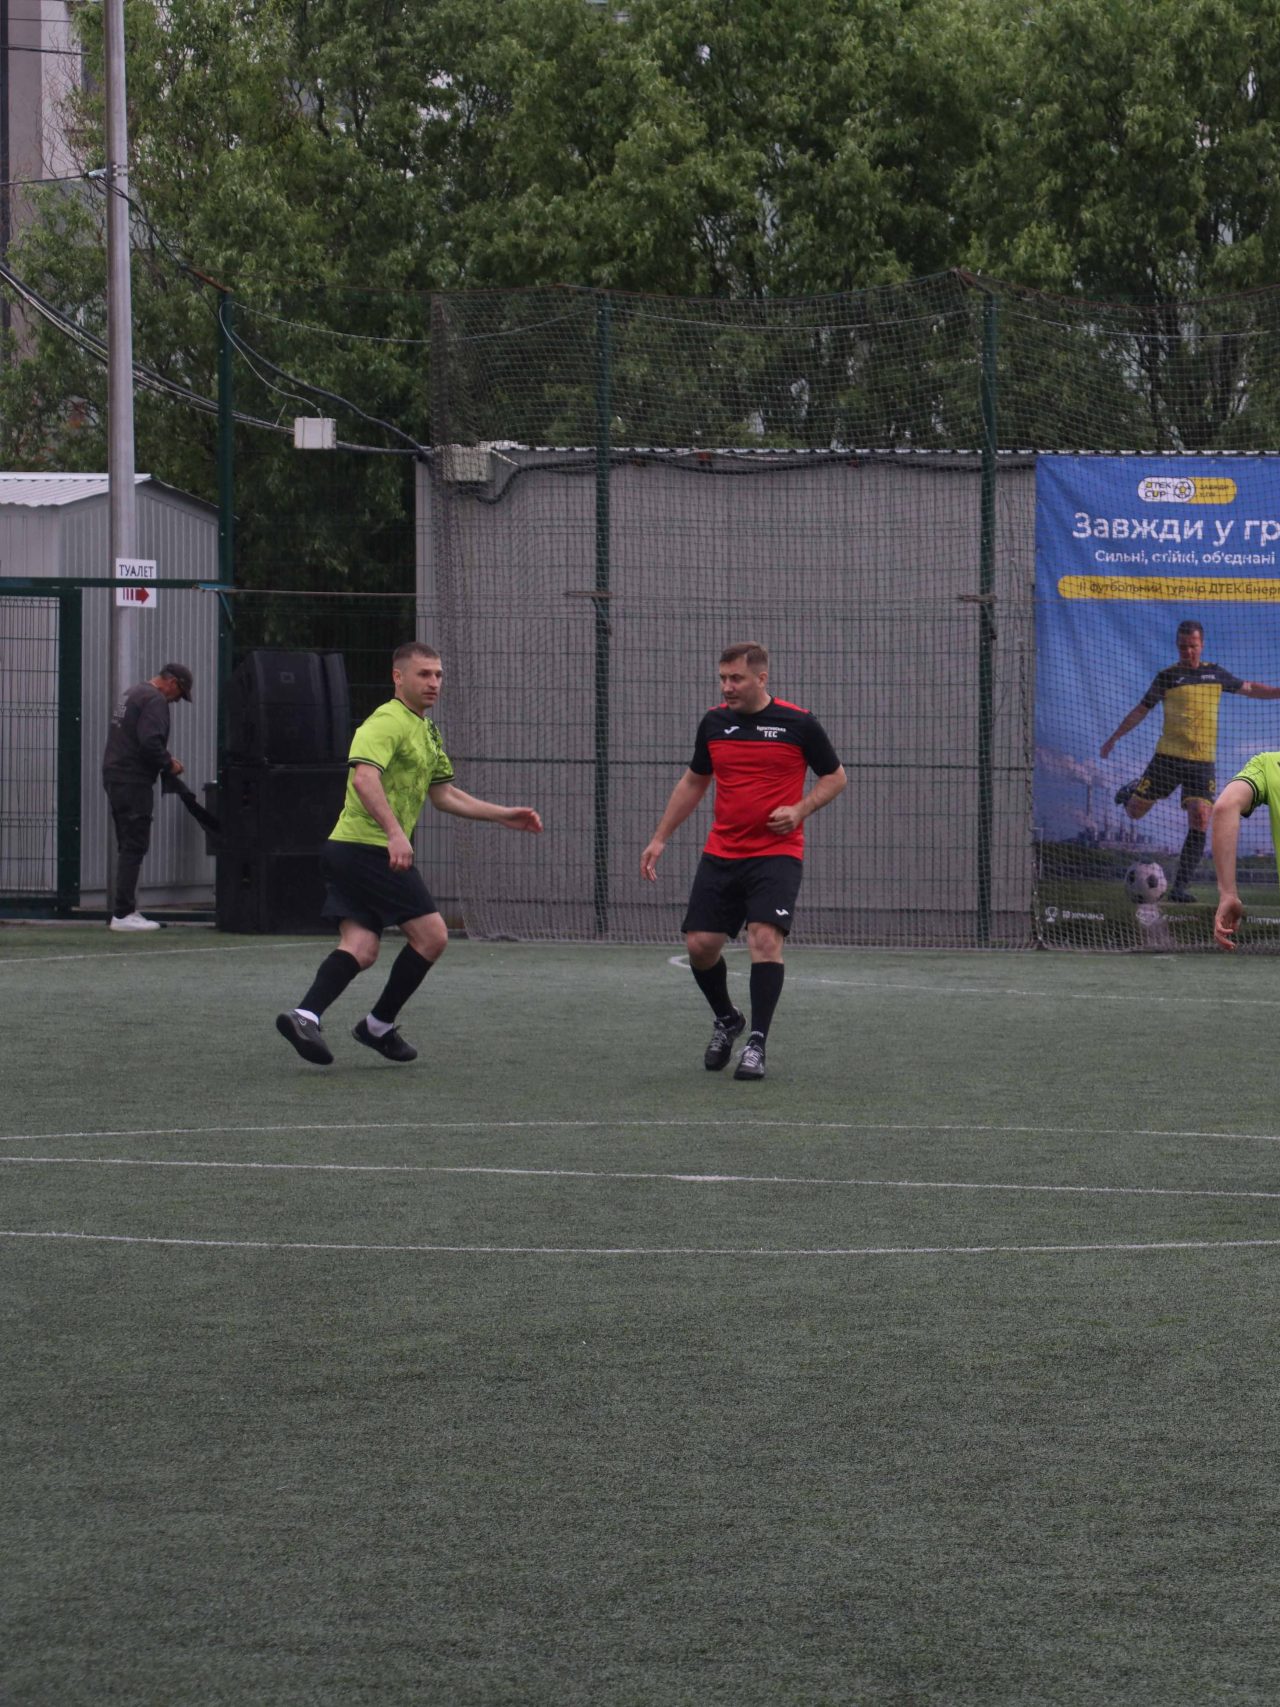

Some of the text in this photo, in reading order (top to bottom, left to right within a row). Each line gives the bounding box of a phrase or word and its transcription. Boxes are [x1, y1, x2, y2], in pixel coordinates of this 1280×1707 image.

[1072, 512, 1203, 543] Завжди
[1212, 519, 1234, 546] у
[1095, 550, 1276, 566] Сильні, стійкі, об'єднані
[119, 564, 154, 578] ТУАЛЕТ
[1090, 580, 1162, 594] футбольний
[1166, 583, 1206, 595] турнір
[1208, 583, 1241, 595] ДТЕК
[764, 730, 778, 738] ТЕС
